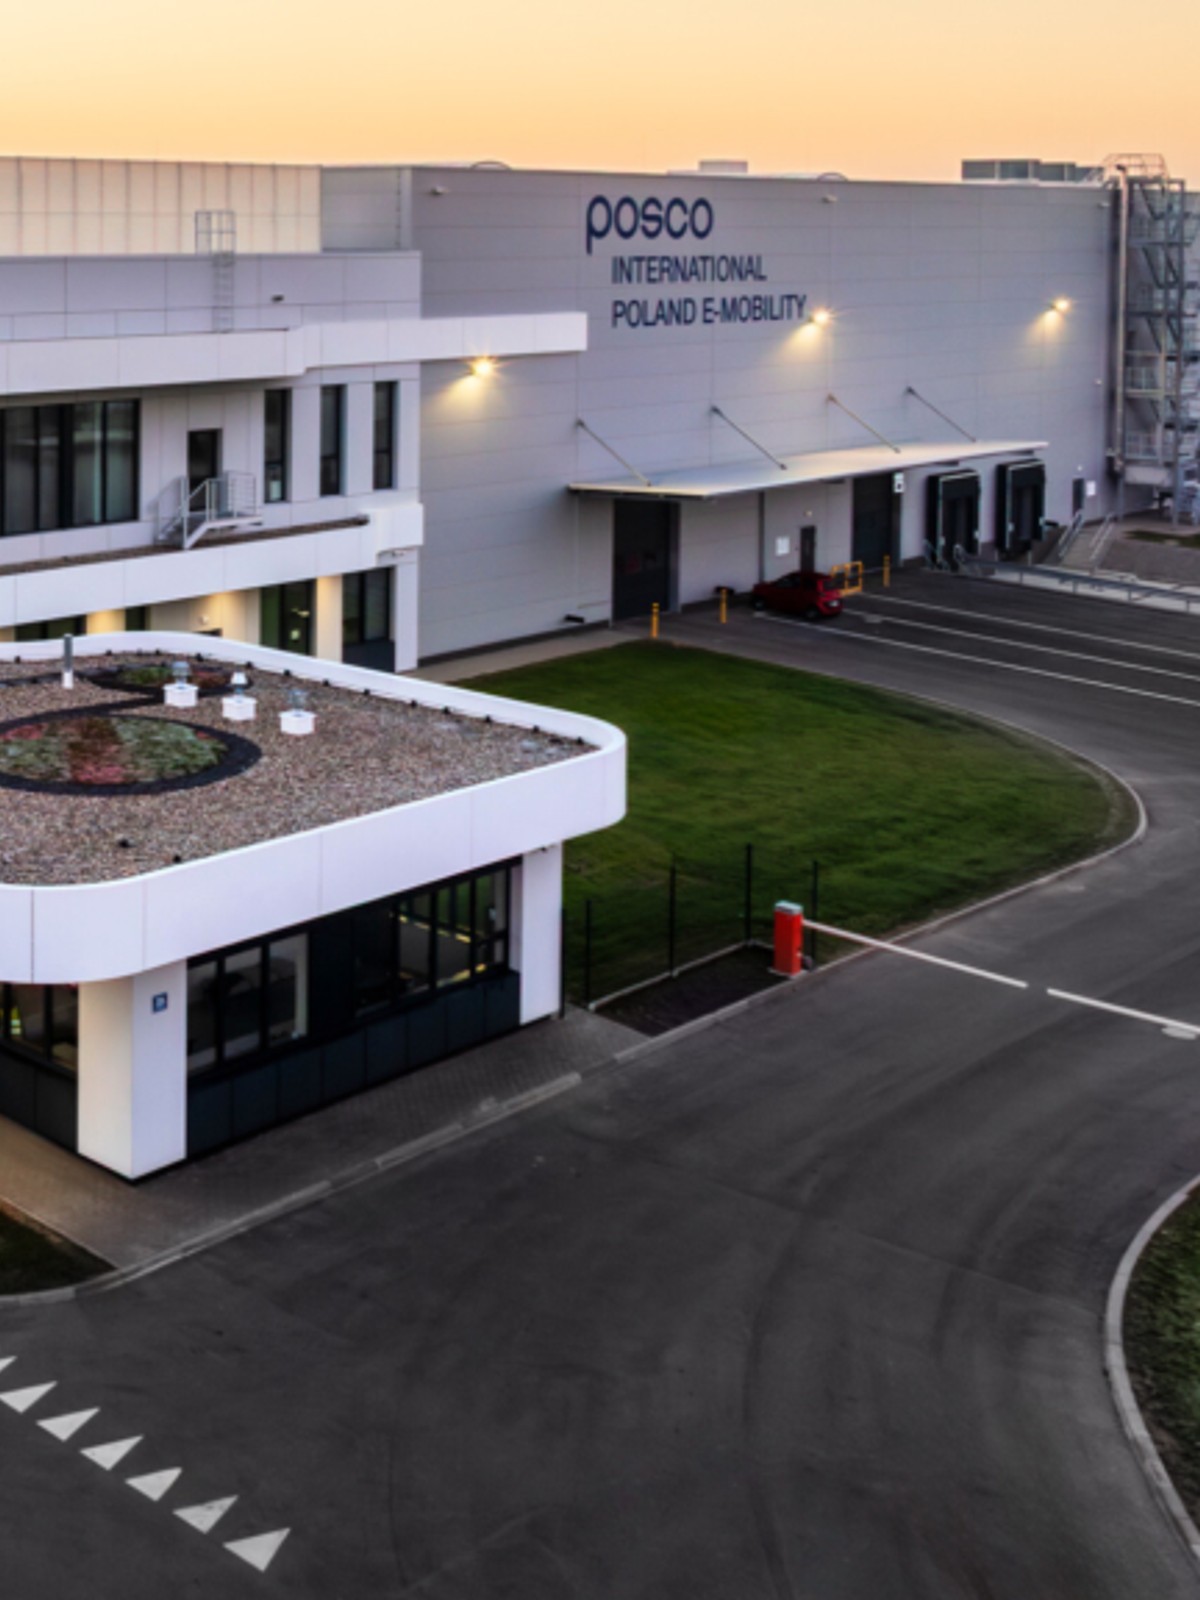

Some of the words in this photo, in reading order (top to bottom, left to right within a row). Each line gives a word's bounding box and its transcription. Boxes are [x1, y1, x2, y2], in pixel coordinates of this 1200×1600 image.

[586, 194, 714, 255] posco
[612, 254, 767, 284] INTERNATIONAL
[612, 298, 696, 328] POLAND
[702, 293, 807, 324] E-MOBILITY
